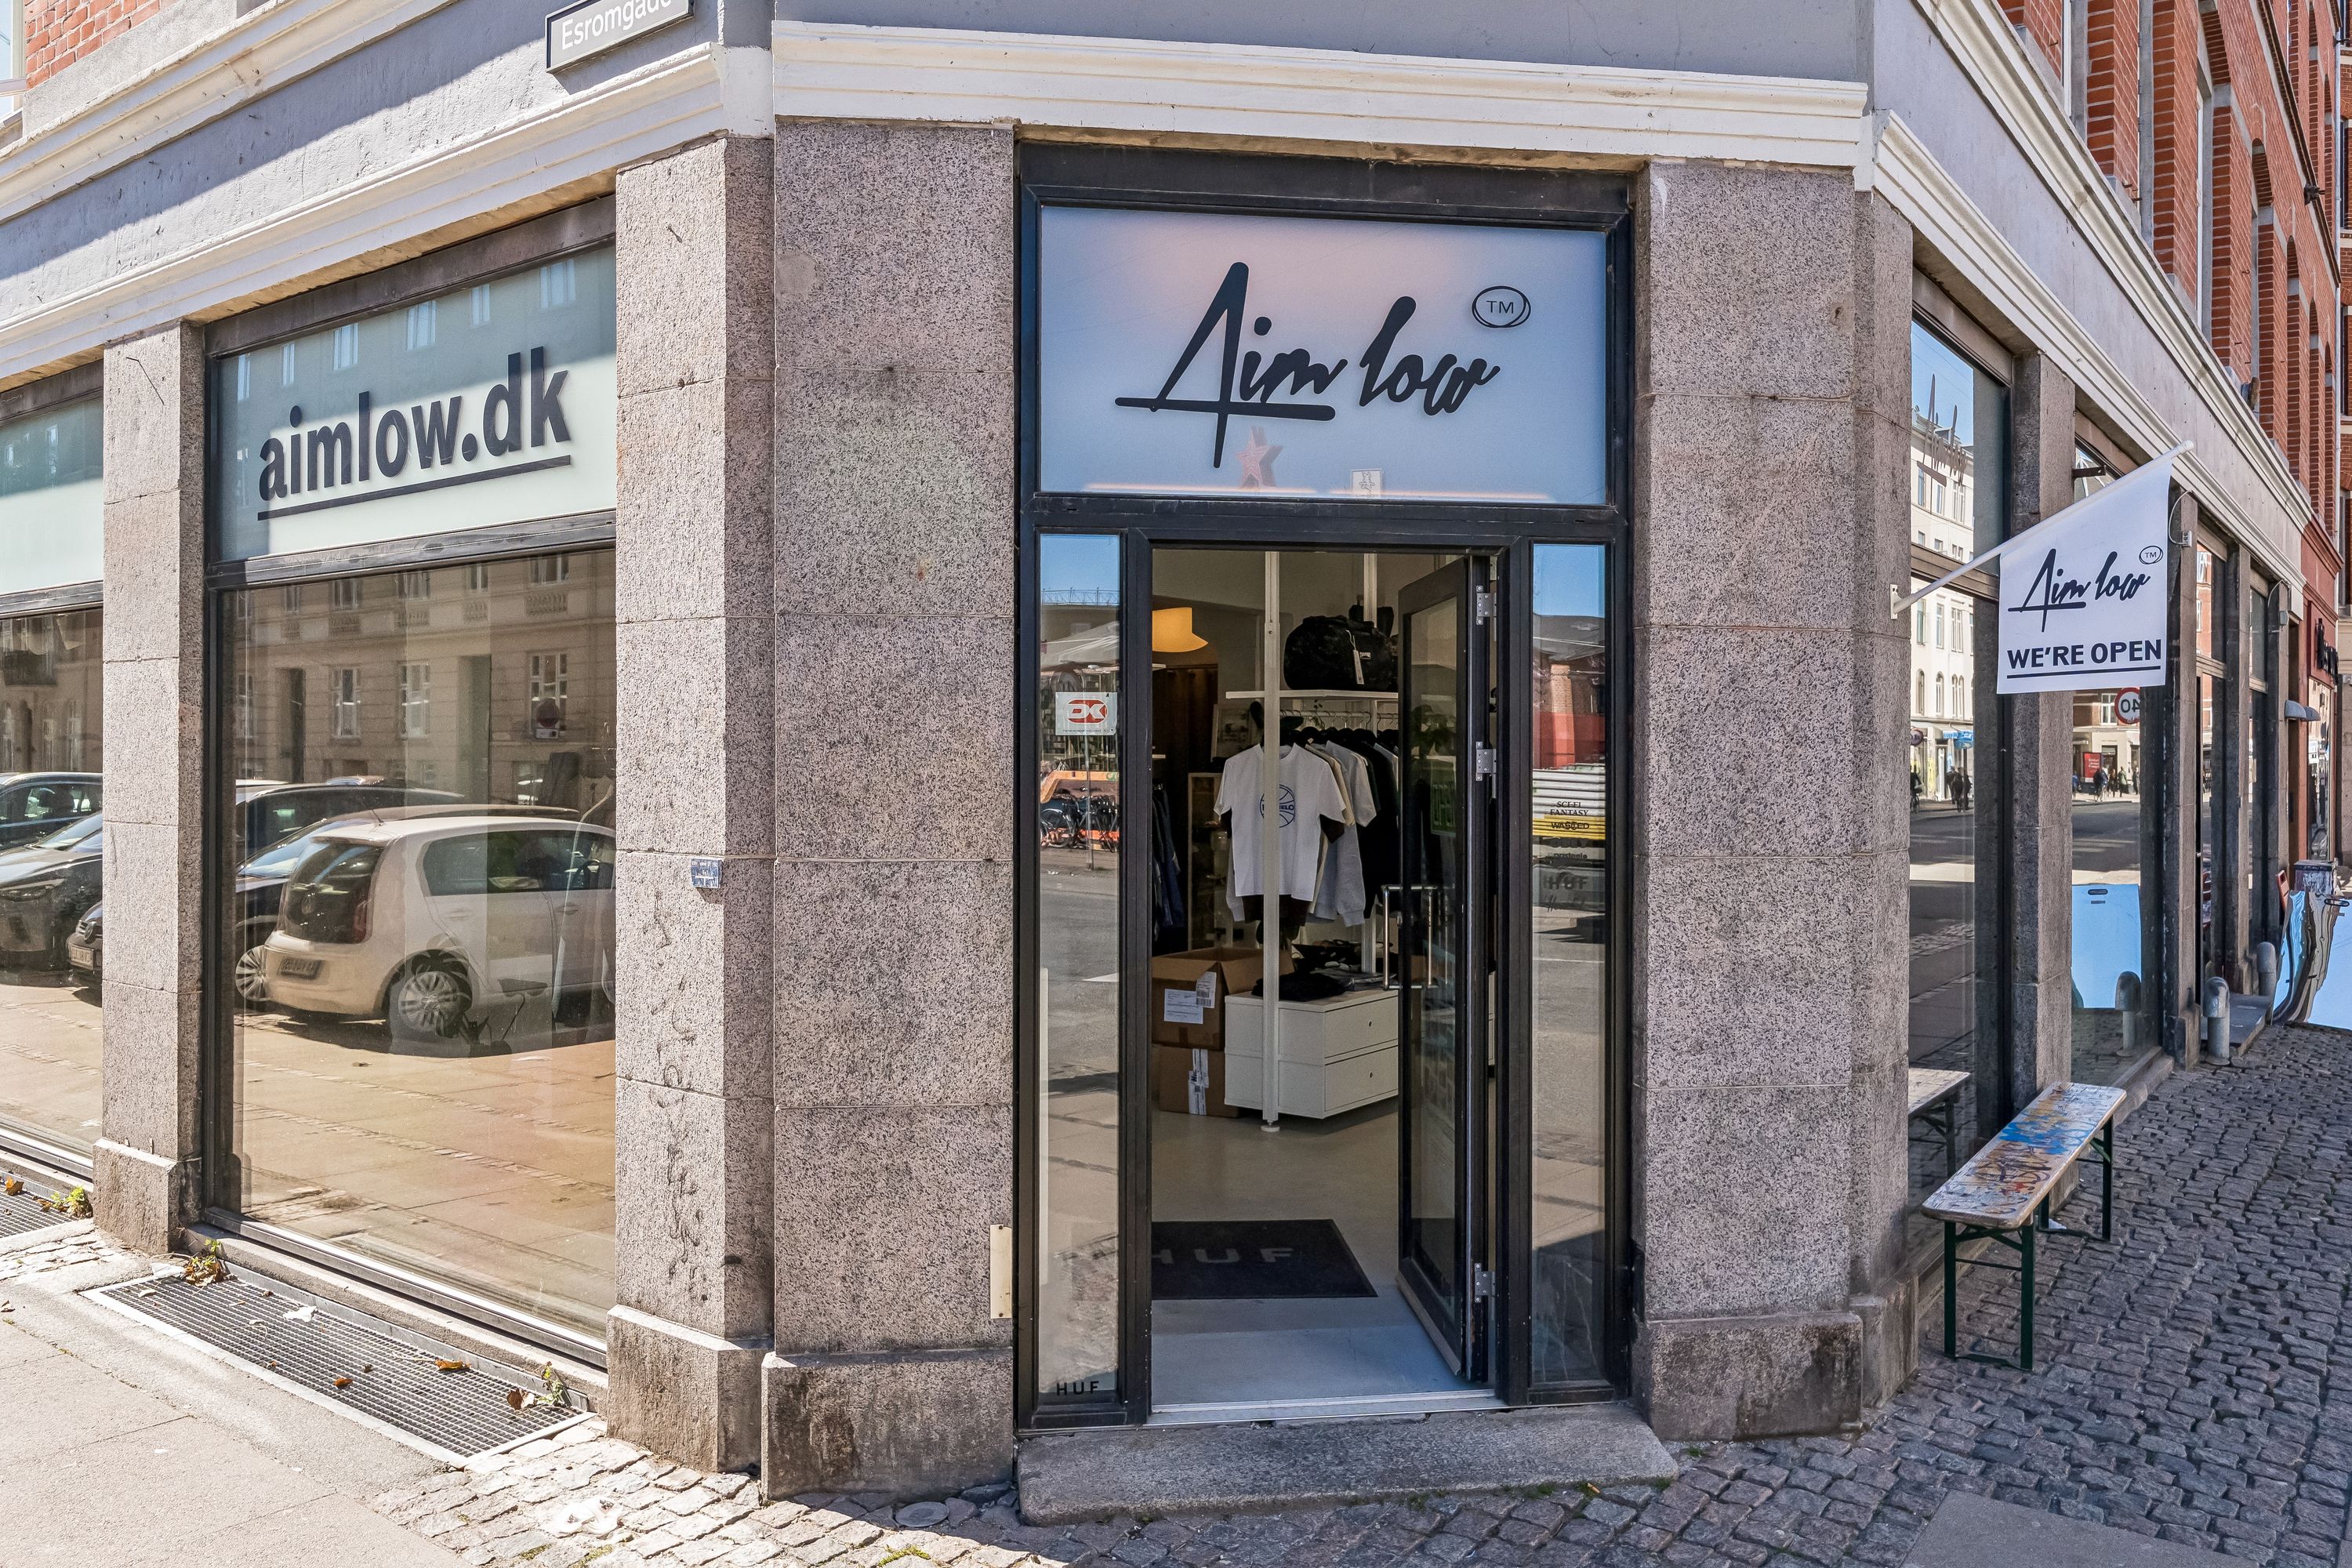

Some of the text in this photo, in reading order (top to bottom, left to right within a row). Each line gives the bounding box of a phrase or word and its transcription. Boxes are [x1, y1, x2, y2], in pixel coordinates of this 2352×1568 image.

[1486, 299, 1515, 314] TM
[1115, 262, 1501, 468] Aim low
[259, 346, 571, 501] aimlow.dk
[2008, 548, 2151, 633] Aim low
[2007, 639, 2161, 669] WE'RE OPEN
[1055, 1380, 1099, 1396] HUF
